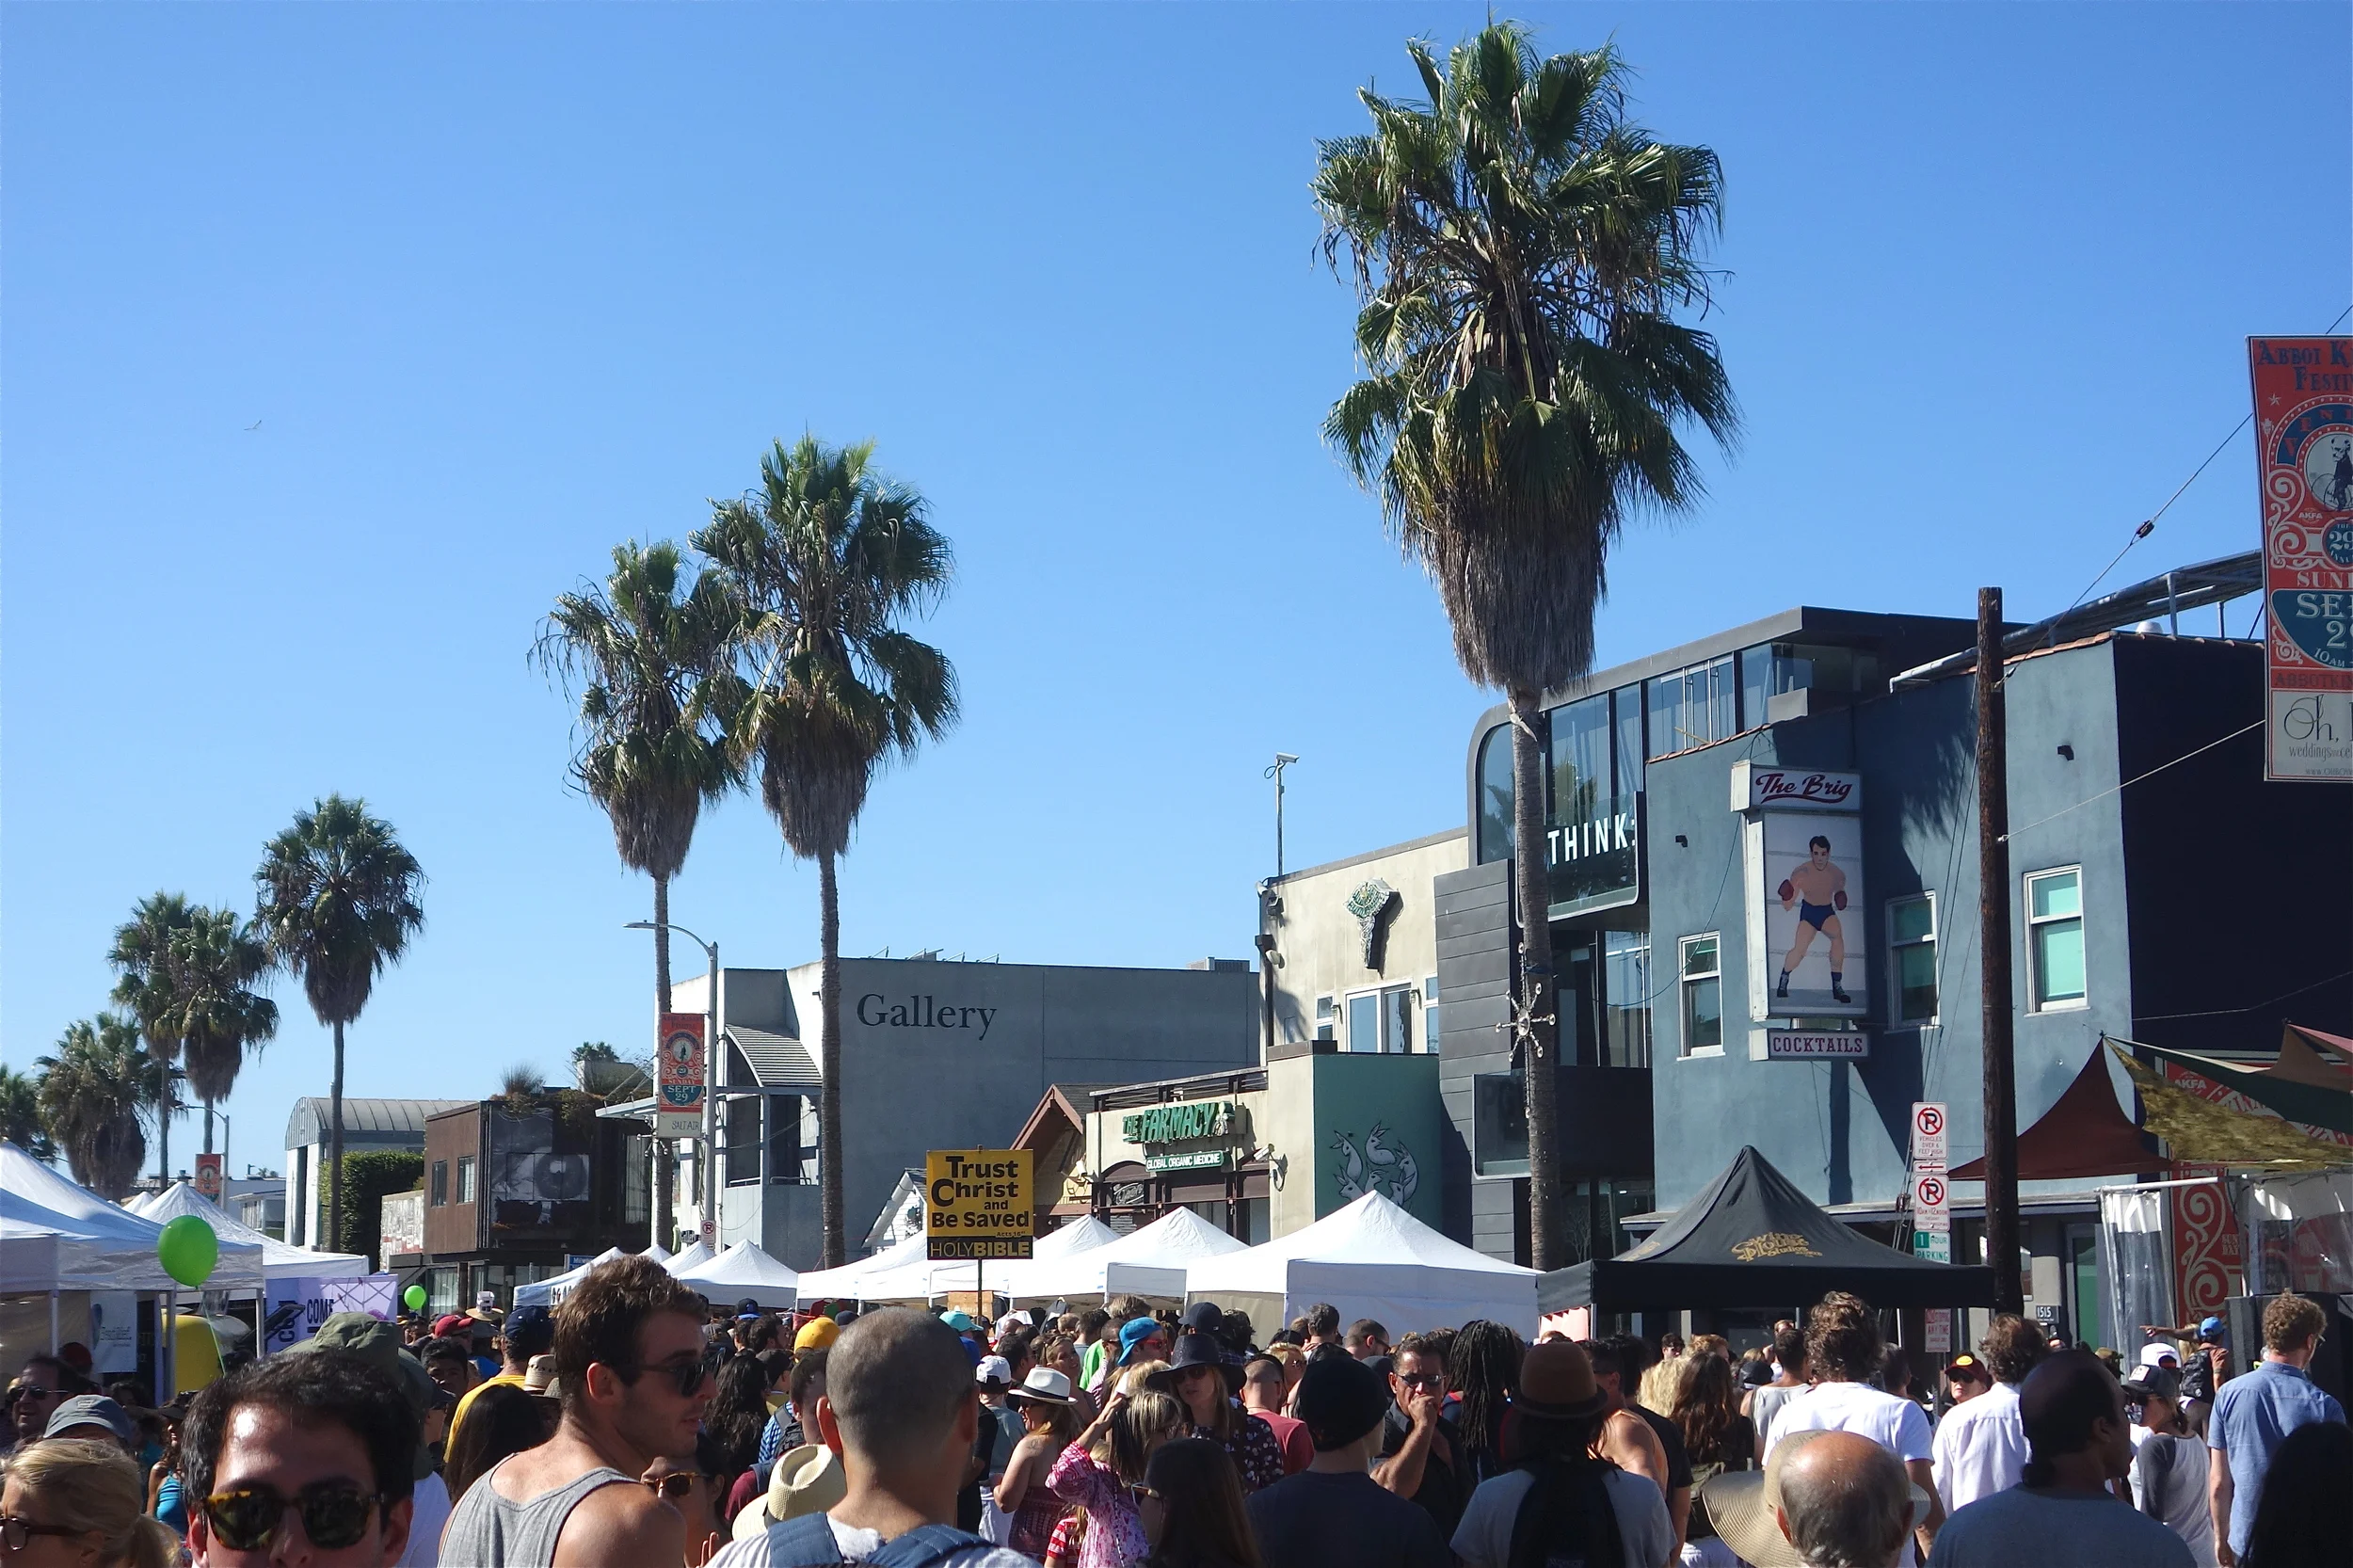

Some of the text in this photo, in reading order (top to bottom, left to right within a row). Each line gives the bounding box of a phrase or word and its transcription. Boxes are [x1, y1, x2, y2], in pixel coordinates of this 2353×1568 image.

[2326, 620, 2353, 648] 2
[1755, 773, 1853, 803] The Brig
[856, 993, 998, 1041] Gallery
[1772, 1037, 1864, 1053] COCKTAILS
[675, 1093, 689, 1102] 29
[1140, 1103, 1216, 1144] FARMACY
[945, 1156, 1019, 1178] Trust
[1146, 1152, 1221, 1170] GLOBAL ORGANIC MEDICINE
[931, 1178, 1019, 1207] Christ
[984, 1200, 1009, 1210] and
[931, 1210, 1030, 1228] Be Saved
[1916, 1251, 1948, 1261] PARKING
[2037, 1306, 2052, 1318] 1515
